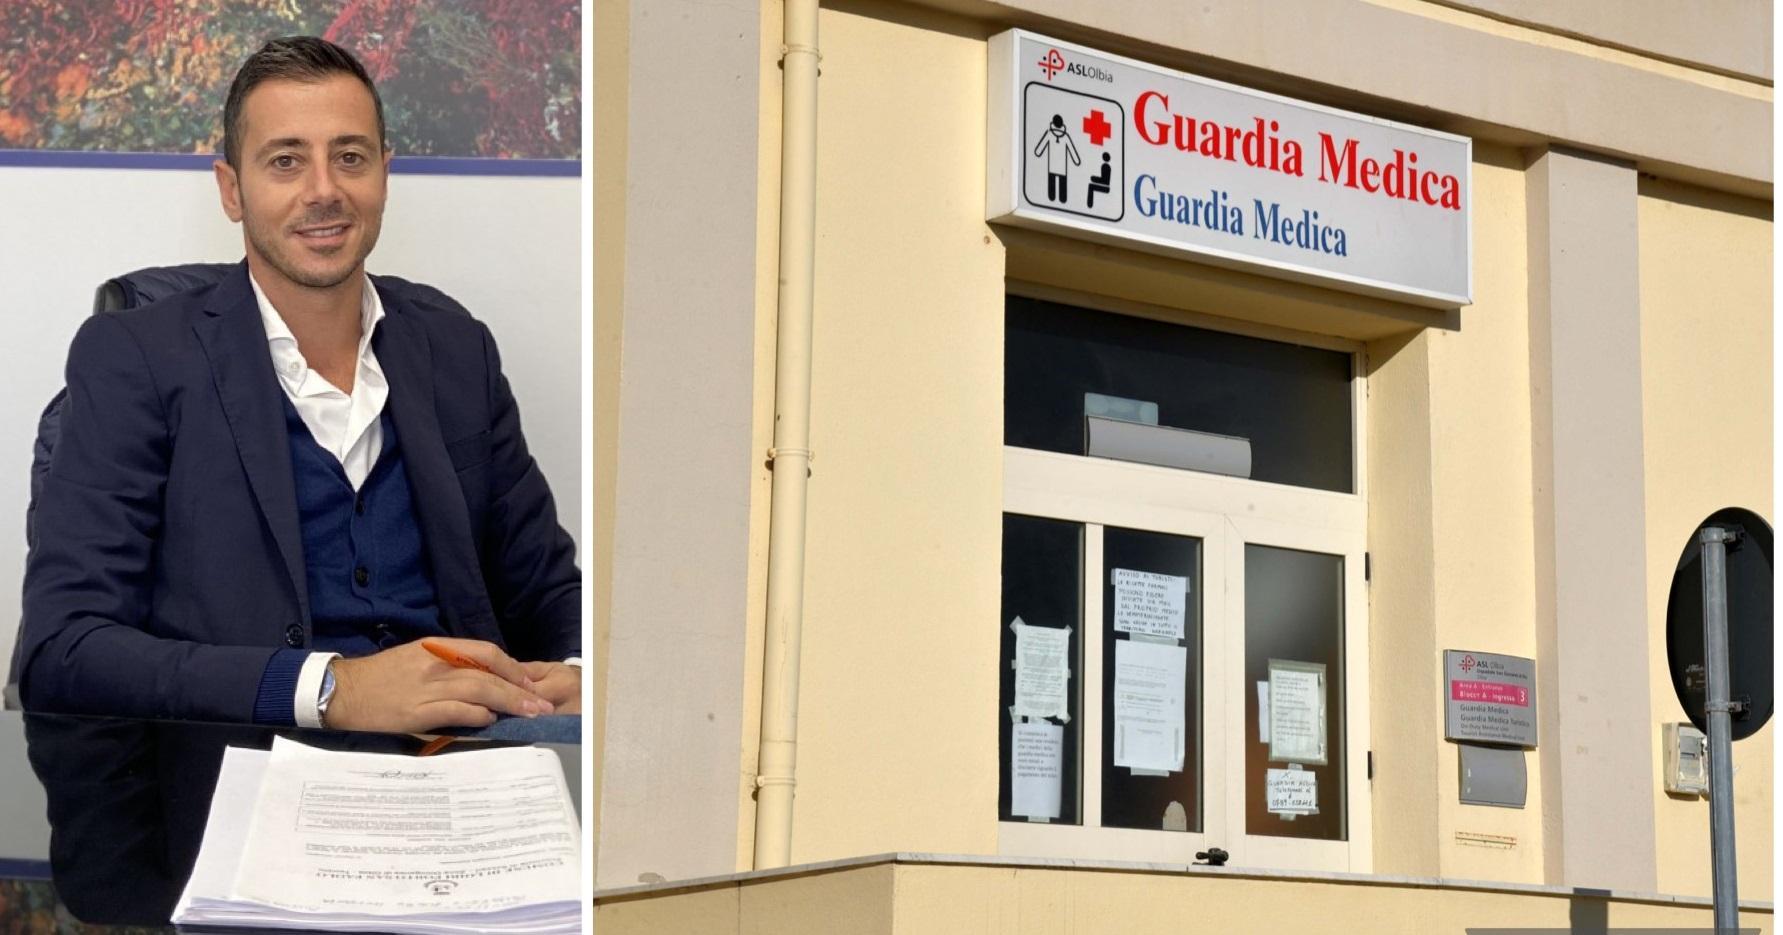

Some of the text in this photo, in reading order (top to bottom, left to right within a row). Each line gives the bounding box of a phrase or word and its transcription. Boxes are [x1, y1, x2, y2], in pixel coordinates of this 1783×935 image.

[1134, 90, 1461, 210] Guardia Medica
[1134, 173, 1347, 257] Guardia Medica
[1477, 660, 1488, 668] ASL
[1520, 691, 1525, 702] 3
[1460, 704, 1509, 714] Guardia Medica
[1461, 714, 1486, 722] Guardia
[1488, 716, 1509, 724] Medica
